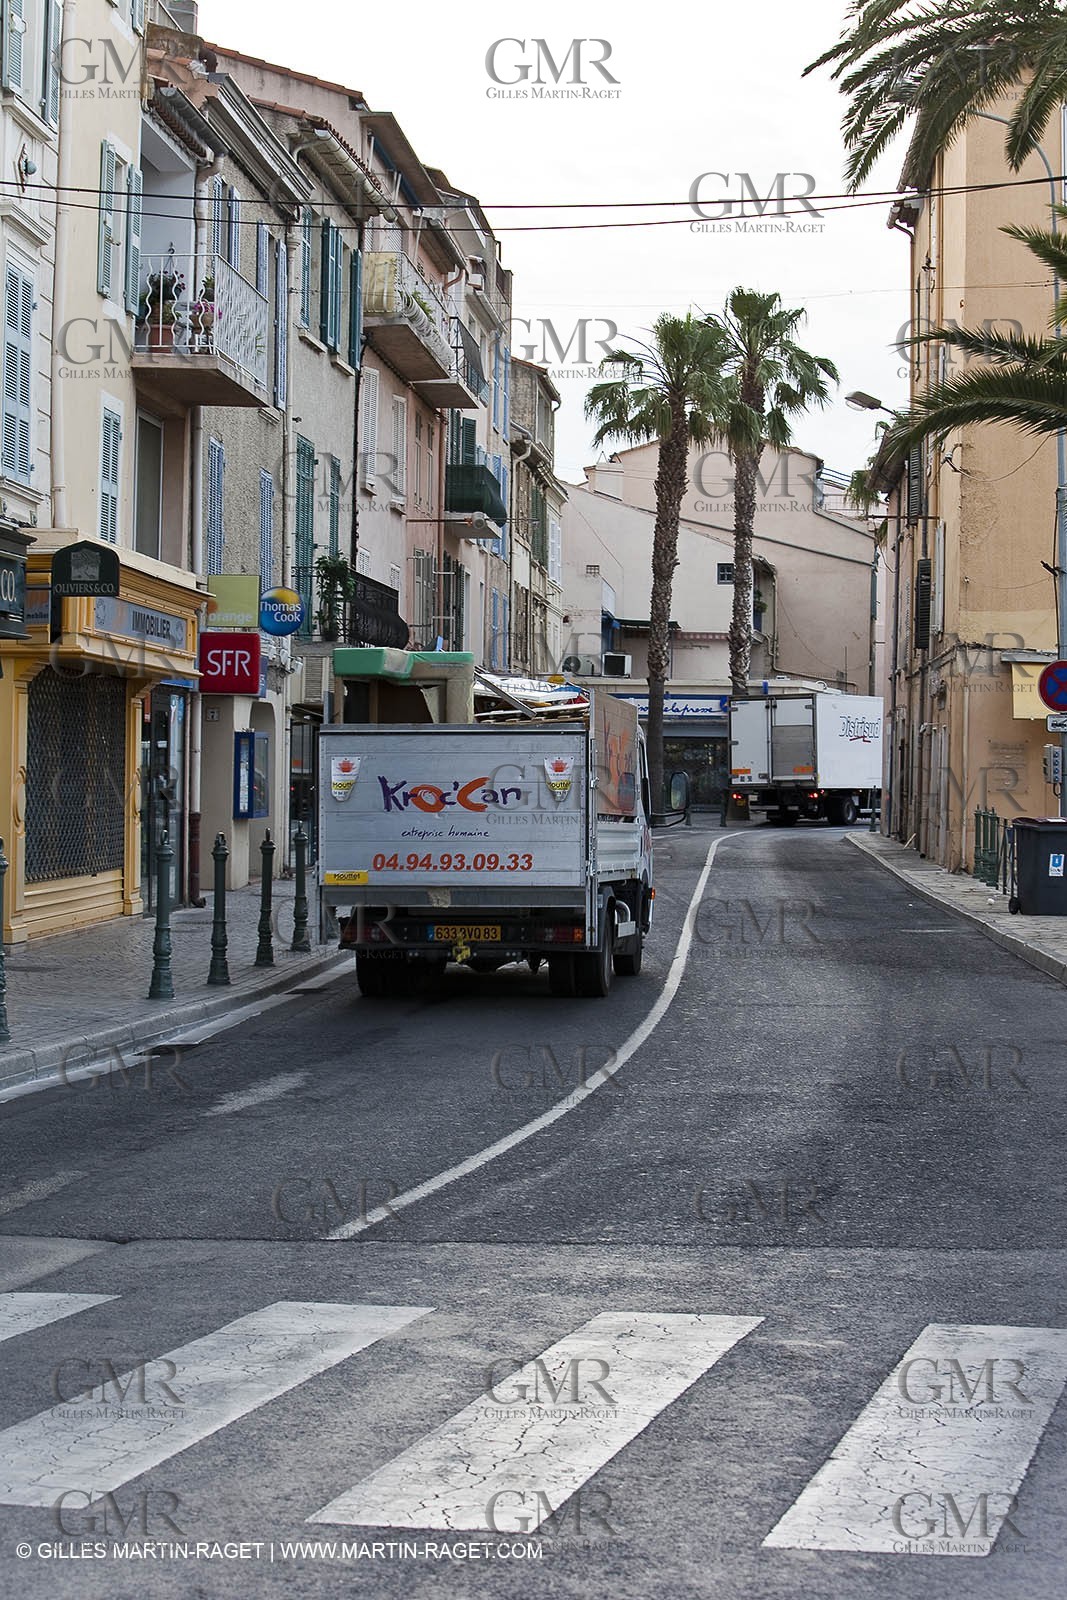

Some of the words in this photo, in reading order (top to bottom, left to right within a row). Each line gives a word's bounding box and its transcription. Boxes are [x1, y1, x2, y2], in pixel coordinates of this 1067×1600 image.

[260, 602, 301, 612] Thomas
[208, 613, 253, 624] orange
[274, 612, 301, 622] Cook
[132, 611, 171, 640] IMMOBILIER
[206, 649, 251, 677] SFR
[448, 825, 490, 837] humaine
[373, 853, 534, 871] 04.94.93.09.33
